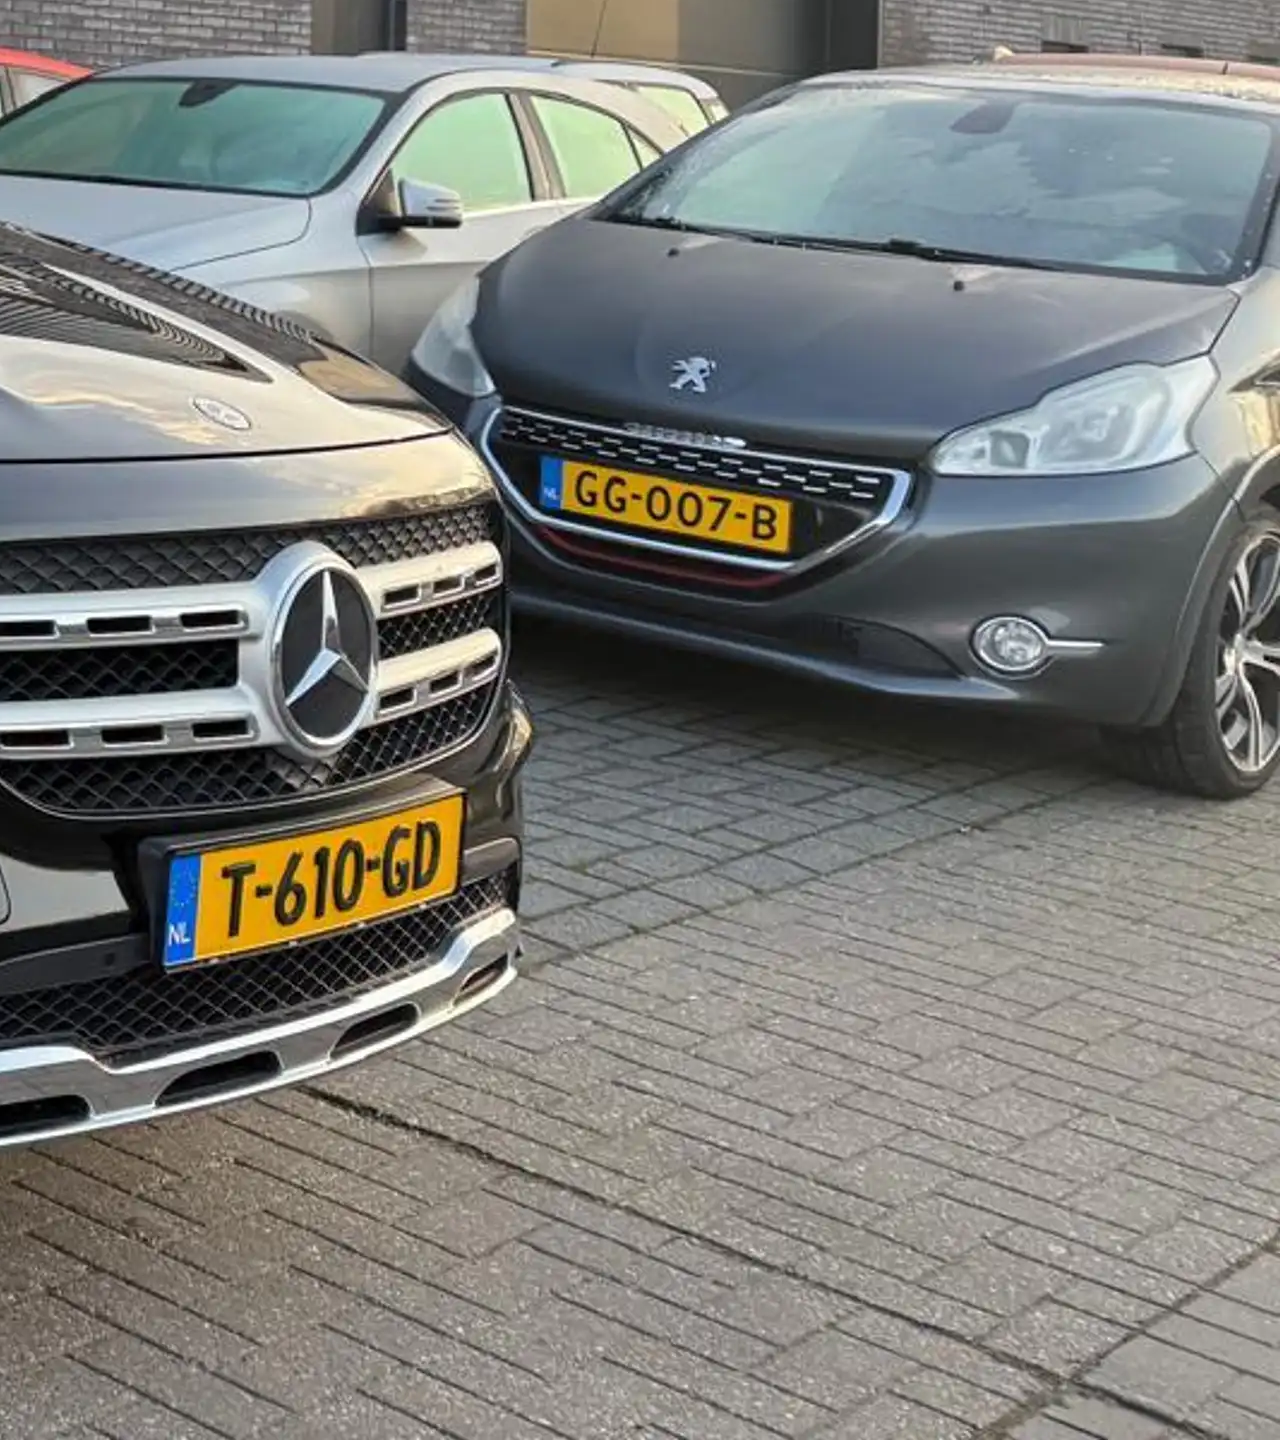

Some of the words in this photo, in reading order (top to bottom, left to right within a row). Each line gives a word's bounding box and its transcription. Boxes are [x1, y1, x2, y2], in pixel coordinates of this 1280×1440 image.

[575, 470, 778, 540] GG-007-B
[168, 922, 192, 947] NL
[221, 820, 441, 938] T-610-GD
